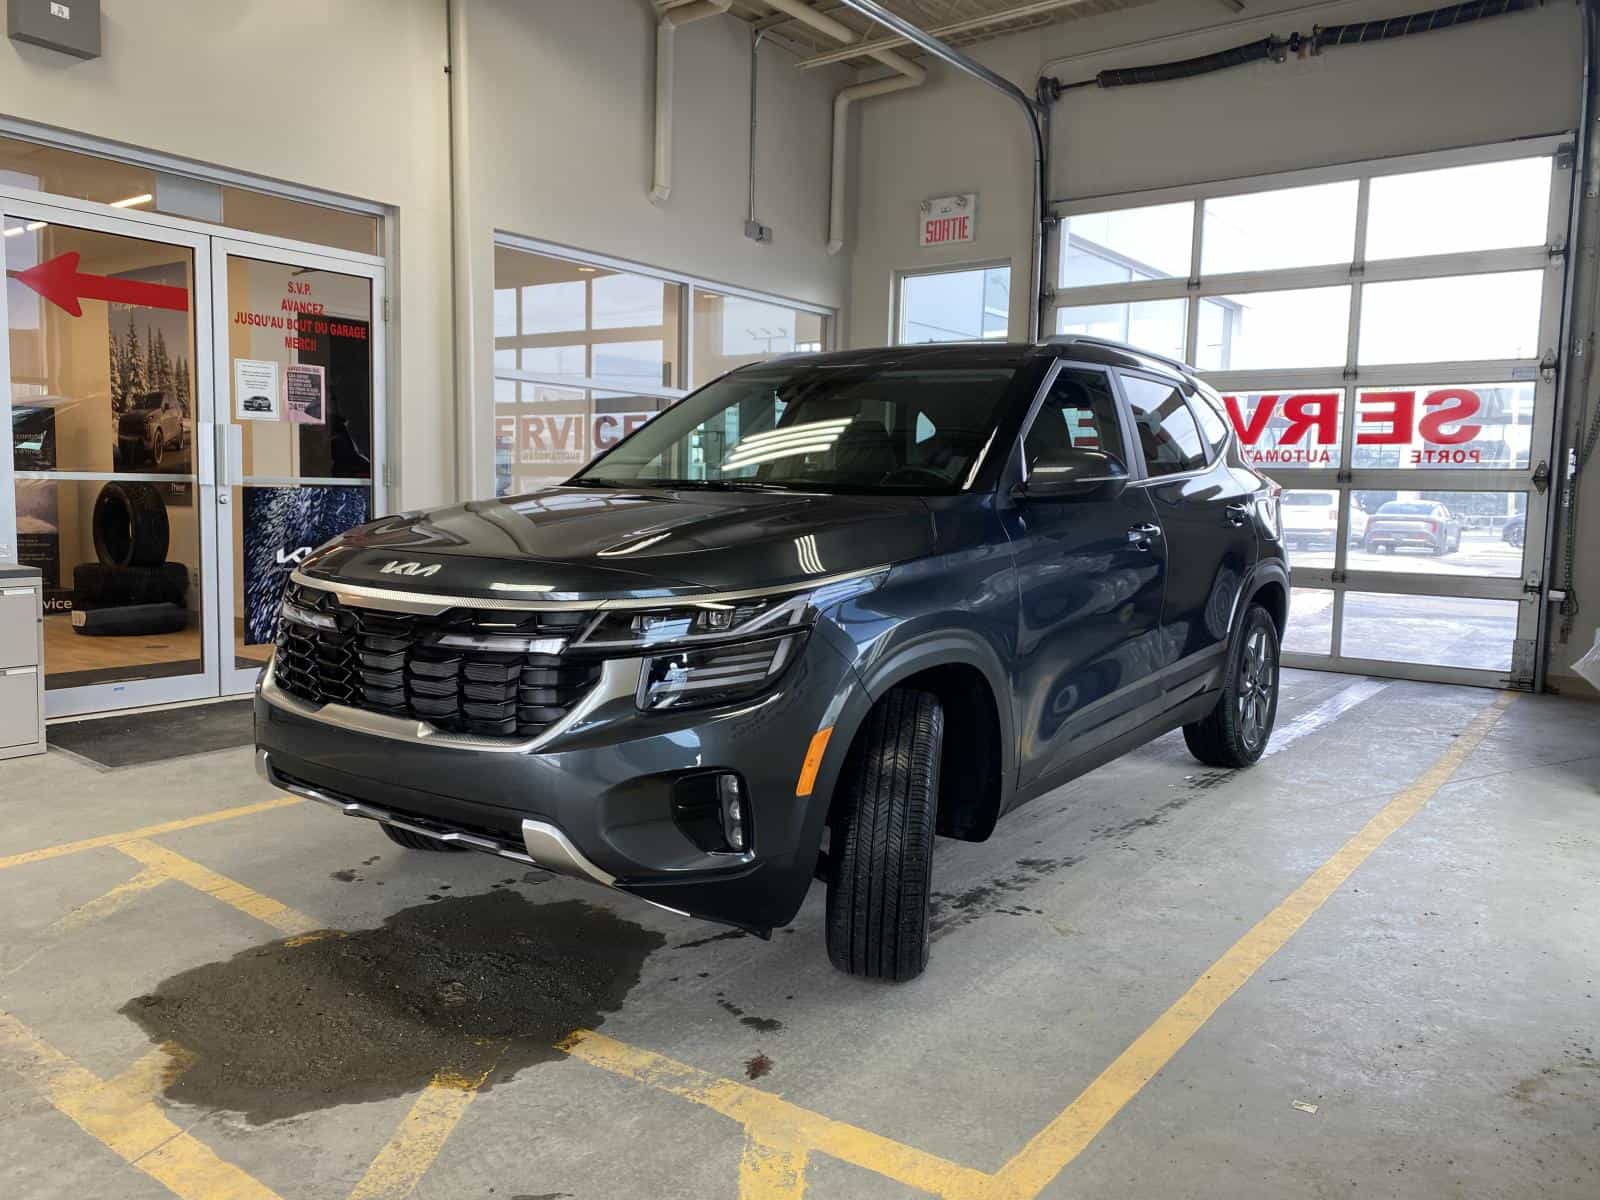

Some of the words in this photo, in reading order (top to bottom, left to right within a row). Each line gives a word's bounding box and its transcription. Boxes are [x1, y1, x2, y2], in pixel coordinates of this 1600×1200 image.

[926, 216, 969, 243] SORTIE
[287, 281, 312, 295] S.V.P.
[281, 299, 324, 315] AVANCEZ
[234, 312, 284, 329] JUSQU'AU
[287, 318, 312, 333] BOUT
[315, 322, 327, 335] DU
[329, 324, 366, 339] GARAGE
